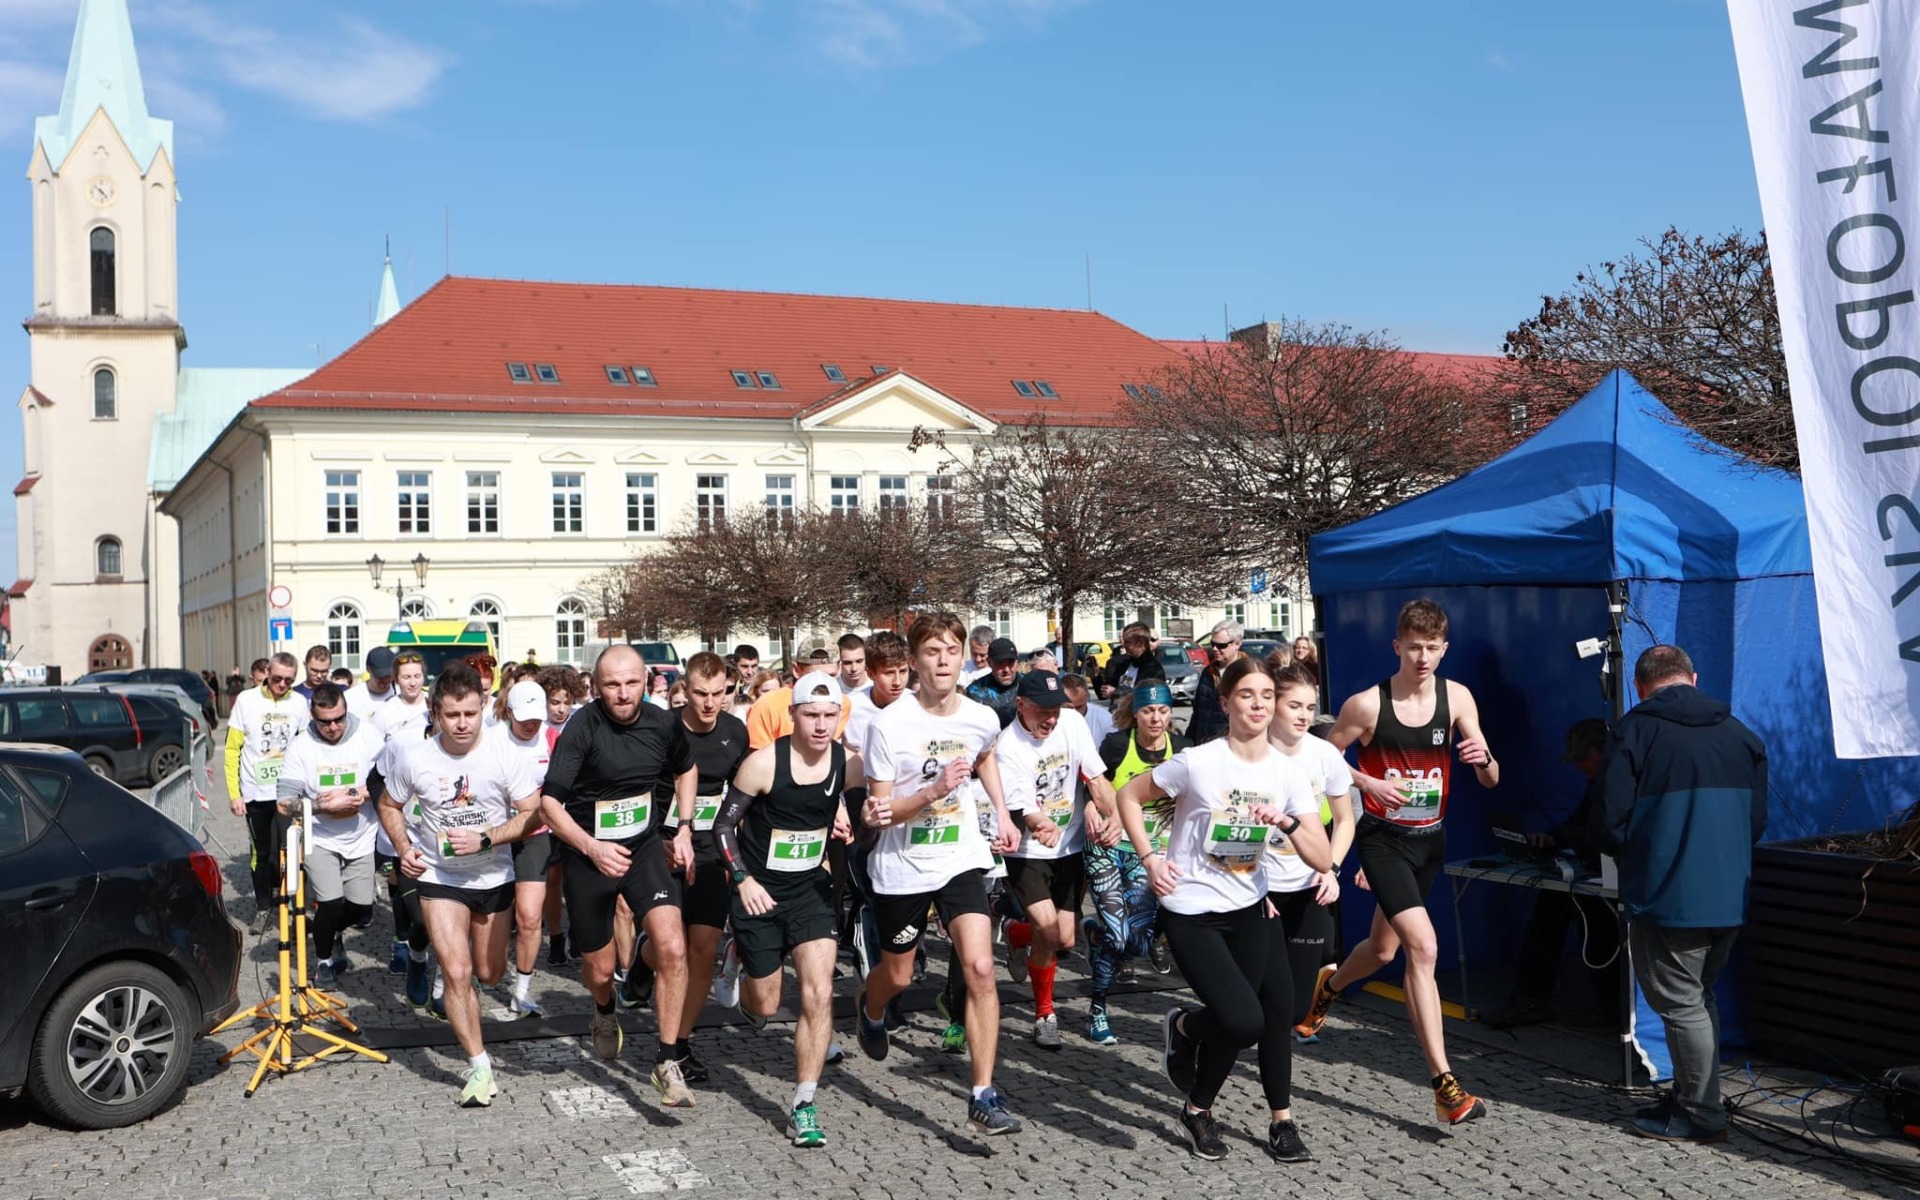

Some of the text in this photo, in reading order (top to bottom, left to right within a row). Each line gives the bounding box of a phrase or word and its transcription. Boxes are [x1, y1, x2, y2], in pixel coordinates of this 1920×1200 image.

[334, 774, 342, 786] 8
[1409, 792, 1427, 807] 42
[615, 810, 635, 826] 38
[927, 828, 946, 845] 17
[1227, 826, 1251, 841] 30
[789, 844, 809, 858] 41
